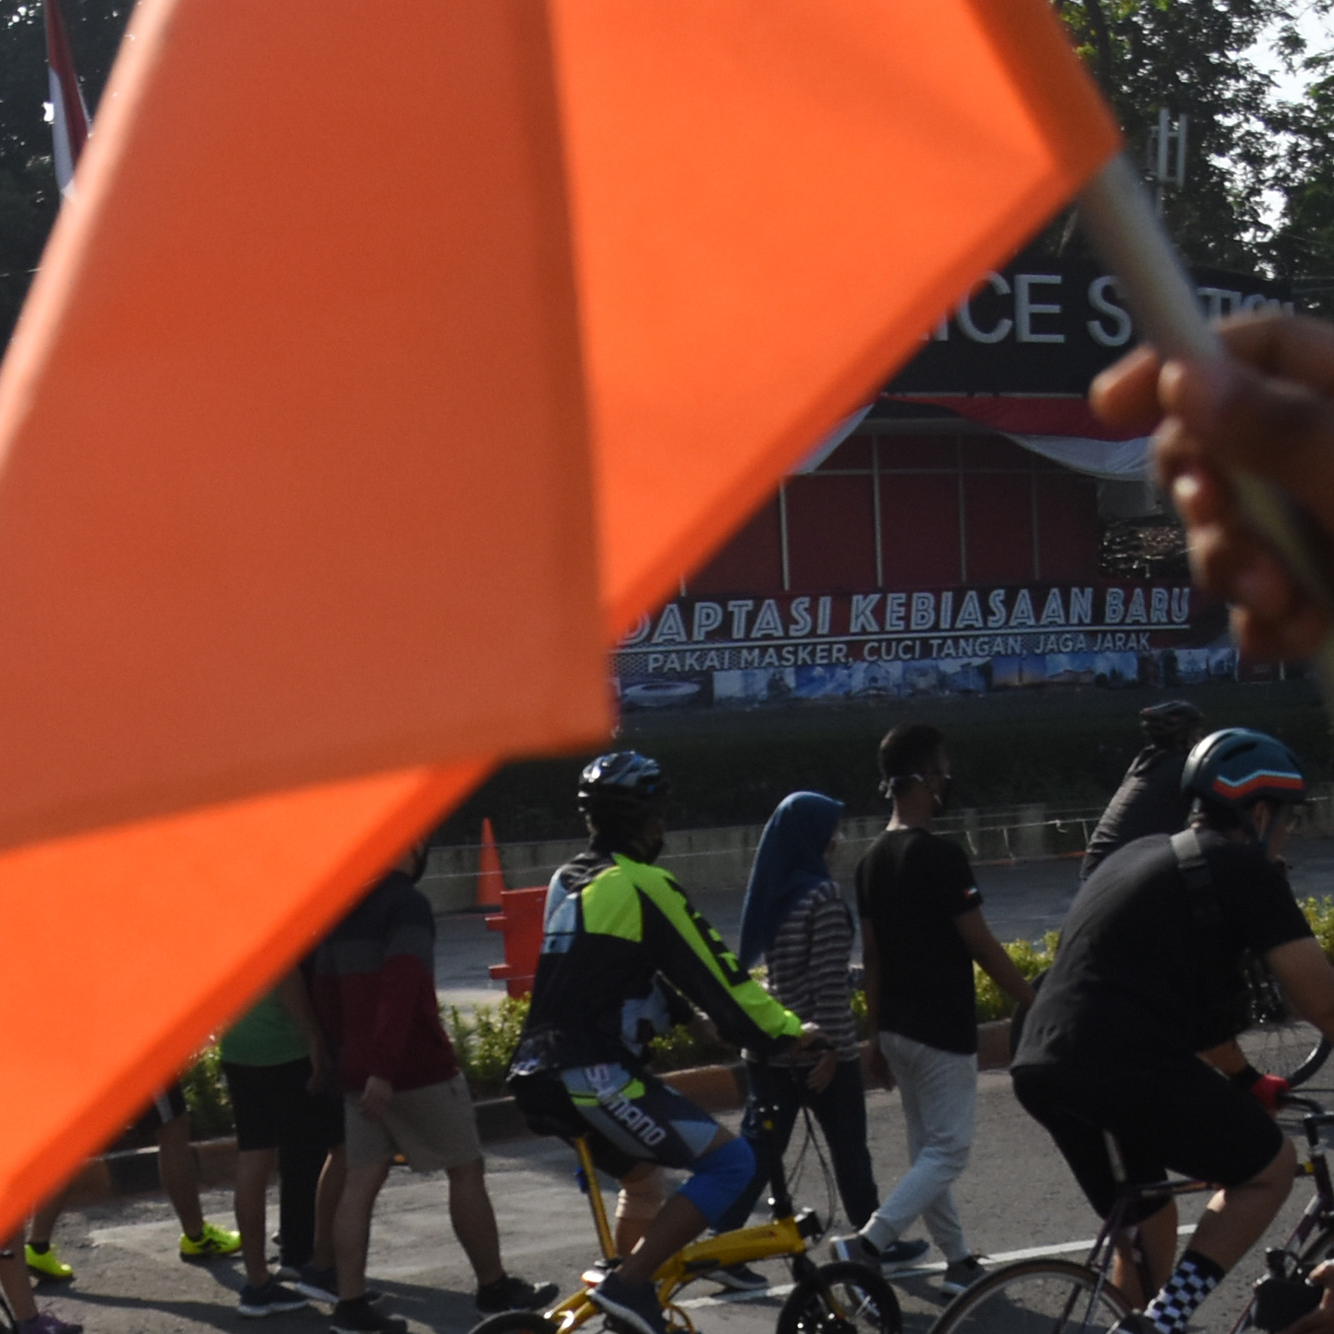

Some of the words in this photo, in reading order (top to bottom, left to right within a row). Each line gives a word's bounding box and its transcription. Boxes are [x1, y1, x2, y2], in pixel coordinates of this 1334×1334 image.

[849, 587, 1094, 634] KEBIASAAN
[1103, 587, 1192, 624] BARU
[647, 649, 732, 674] PAKAI
[862, 638, 921, 662] CUCI
[1034, 632, 1088, 655] JAGA
[1093, 630, 1153, 652] JARAK
